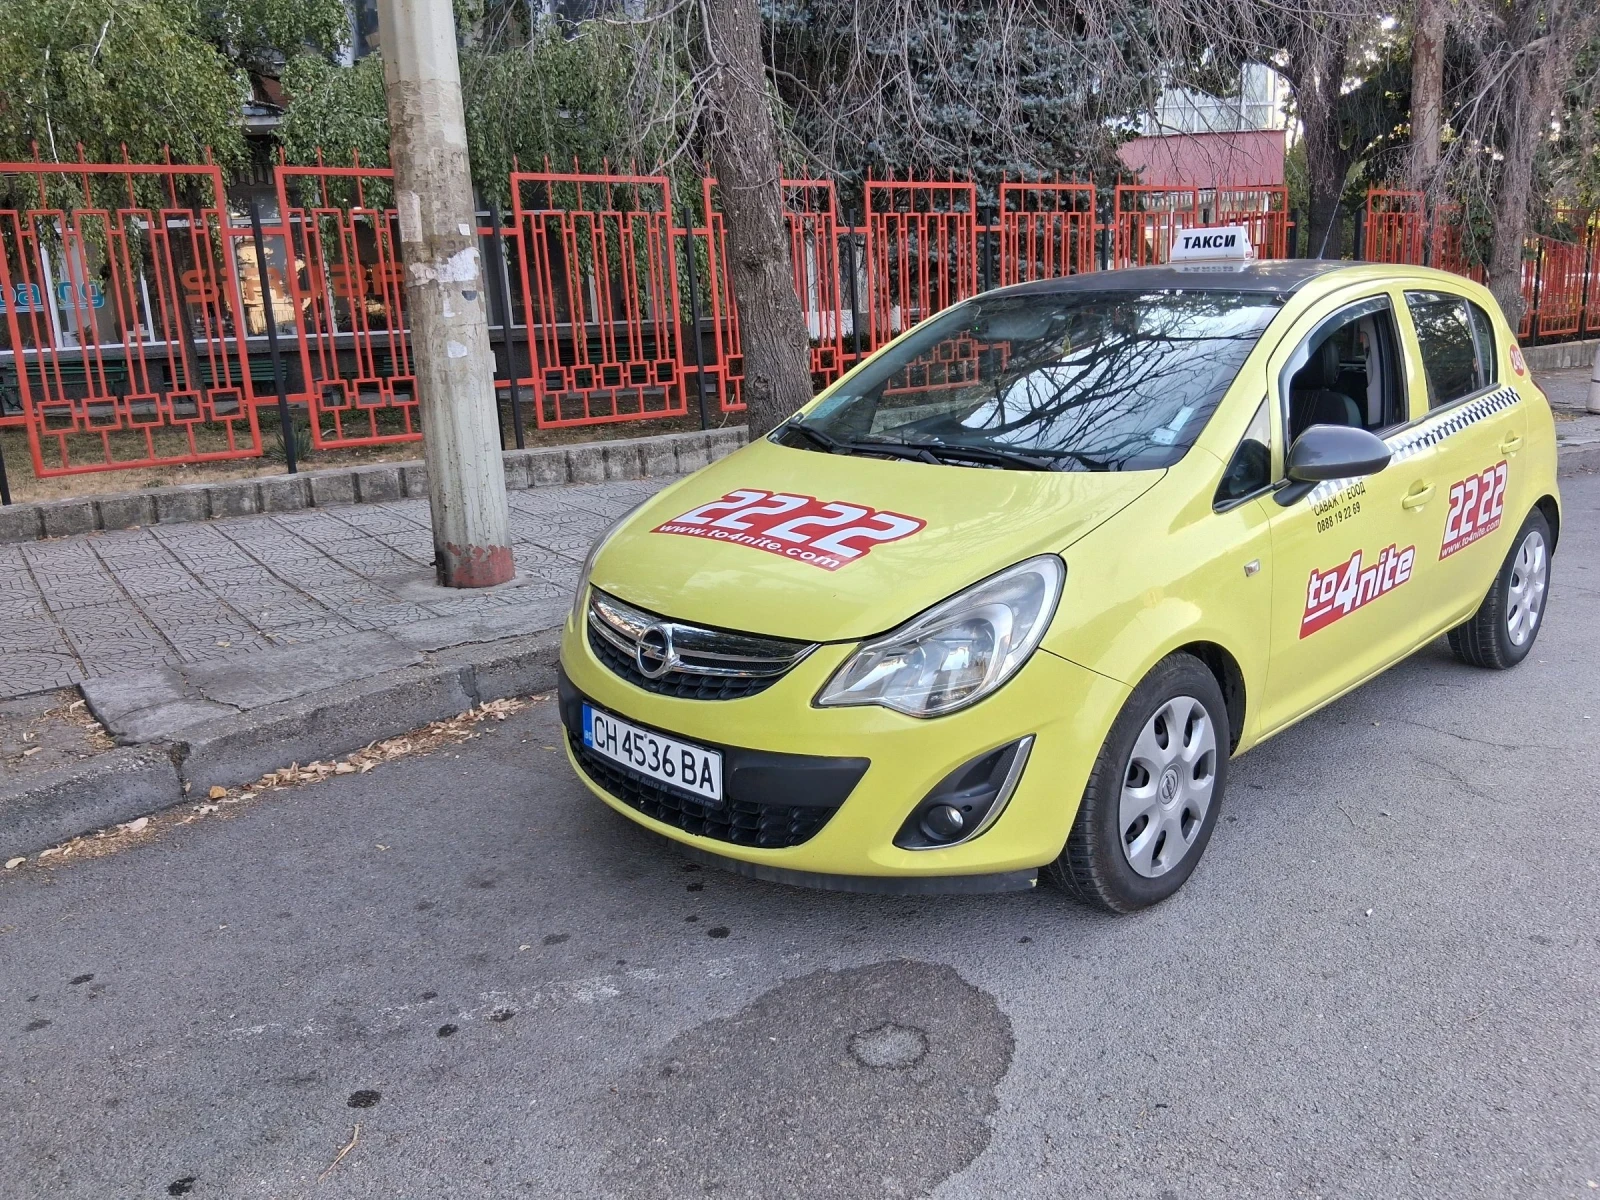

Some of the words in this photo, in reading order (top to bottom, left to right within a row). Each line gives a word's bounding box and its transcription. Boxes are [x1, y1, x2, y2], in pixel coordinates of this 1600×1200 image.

[1183, 234, 1237, 250] ТАКСИ
[1347, 481, 1367, 500] ЕООД
[1316, 516, 1334, 533] 0888
[1334, 510, 1343, 525] 19
[1343, 506, 1352, 520] 22
[1352, 501, 1361, 515] 69
[659, 524, 840, 568] www.to4nite.com
[1441, 519, 1500, 557] www.to4nite.com
[1307, 546, 1414, 614] to4nite
[594, 716, 618, 755] CH
[622, 730, 676, 778] 4536
[681, 749, 715, 793] BA
